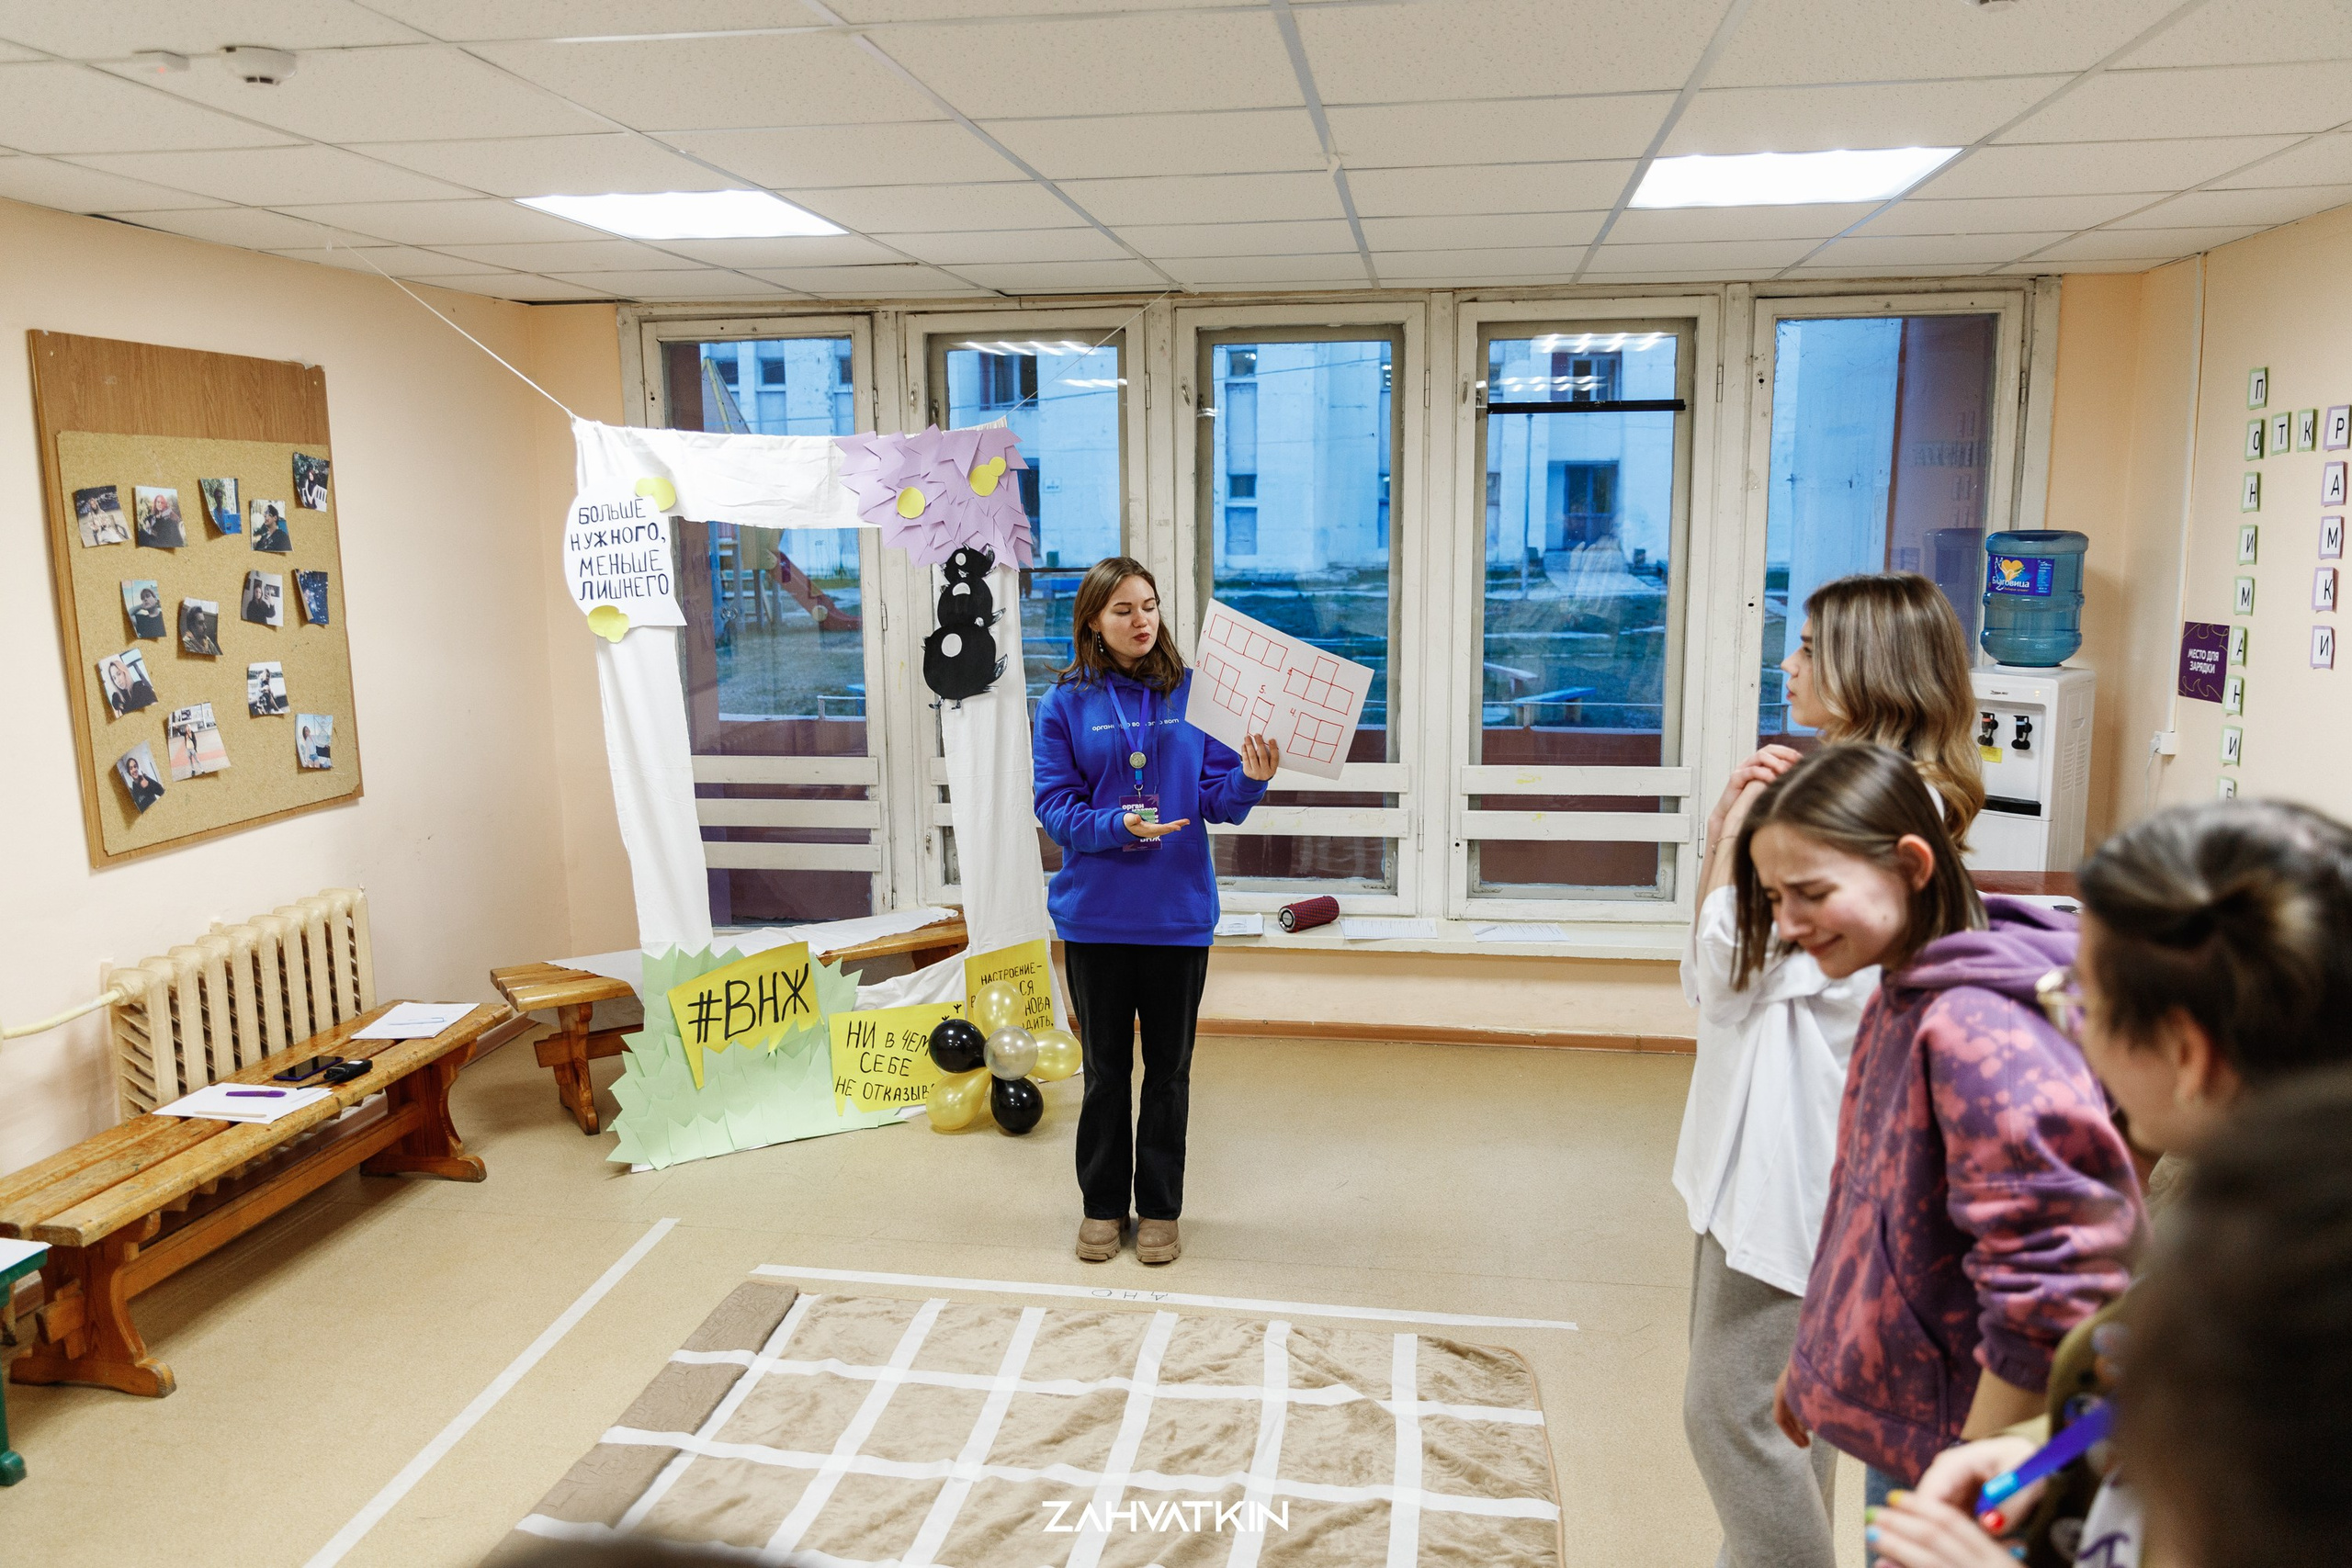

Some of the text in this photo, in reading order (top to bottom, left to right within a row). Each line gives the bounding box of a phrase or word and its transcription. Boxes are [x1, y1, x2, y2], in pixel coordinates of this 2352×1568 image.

[579, 498, 647, 525] БОЛЬШЕ
[571, 522, 666, 551] НУЖНОГО,
[580, 549, 663, 578] МЕНЬШЕ
[579, 573, 669, 601] ЛИШНЕГО
[2188, 649, 2220, 662] МЕСТО ДЛЯ
[2188, 660, 2216, 674] ЗАРЯДКИ
[687, 963, 810, 1044] #ВНЖ
[846, 1020, 876, 1049] НИ
[901, 1029, 930, 1056] ЧЕМ
[859, 1051, 912, 1077] СЕБЕ
[834, 1076, 935, 1102] НЕ ОТКАЗЫВ
